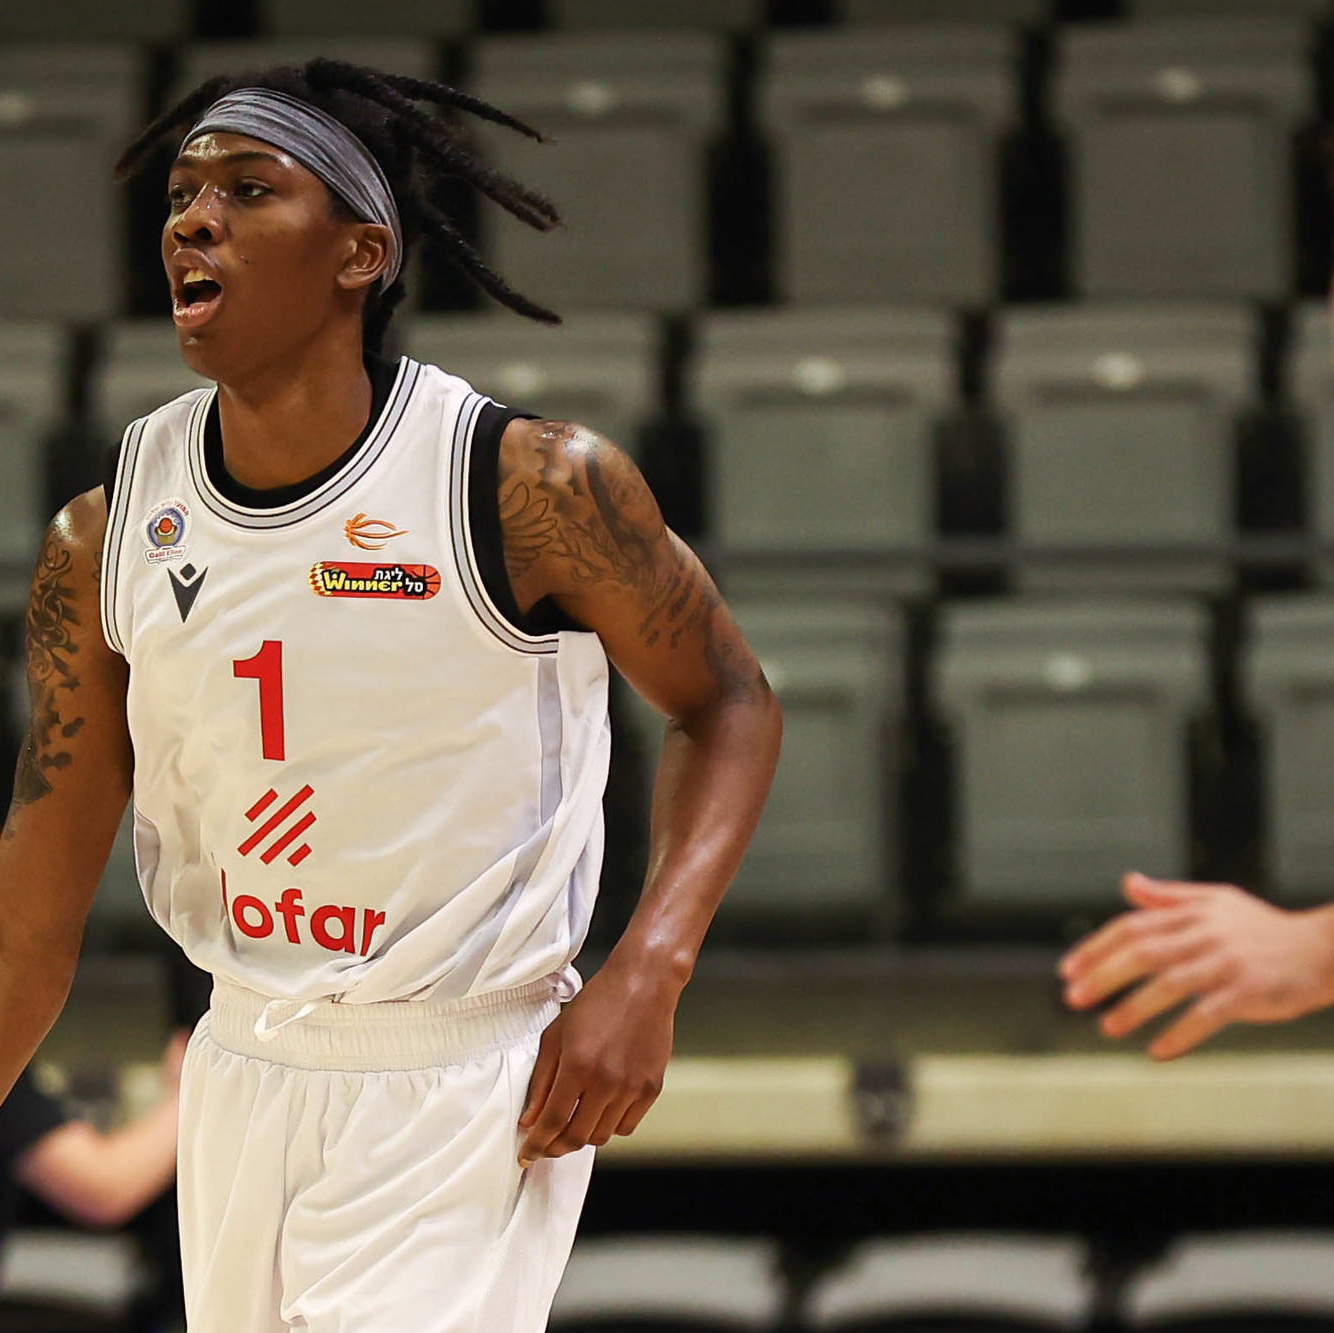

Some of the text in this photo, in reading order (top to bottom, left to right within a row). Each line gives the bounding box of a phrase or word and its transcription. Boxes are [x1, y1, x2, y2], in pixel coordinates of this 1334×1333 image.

[323, 569, 424, 593] Winner סל
[232, 640, 285, 761] 1
[220, 868, 386, 957] ofar
